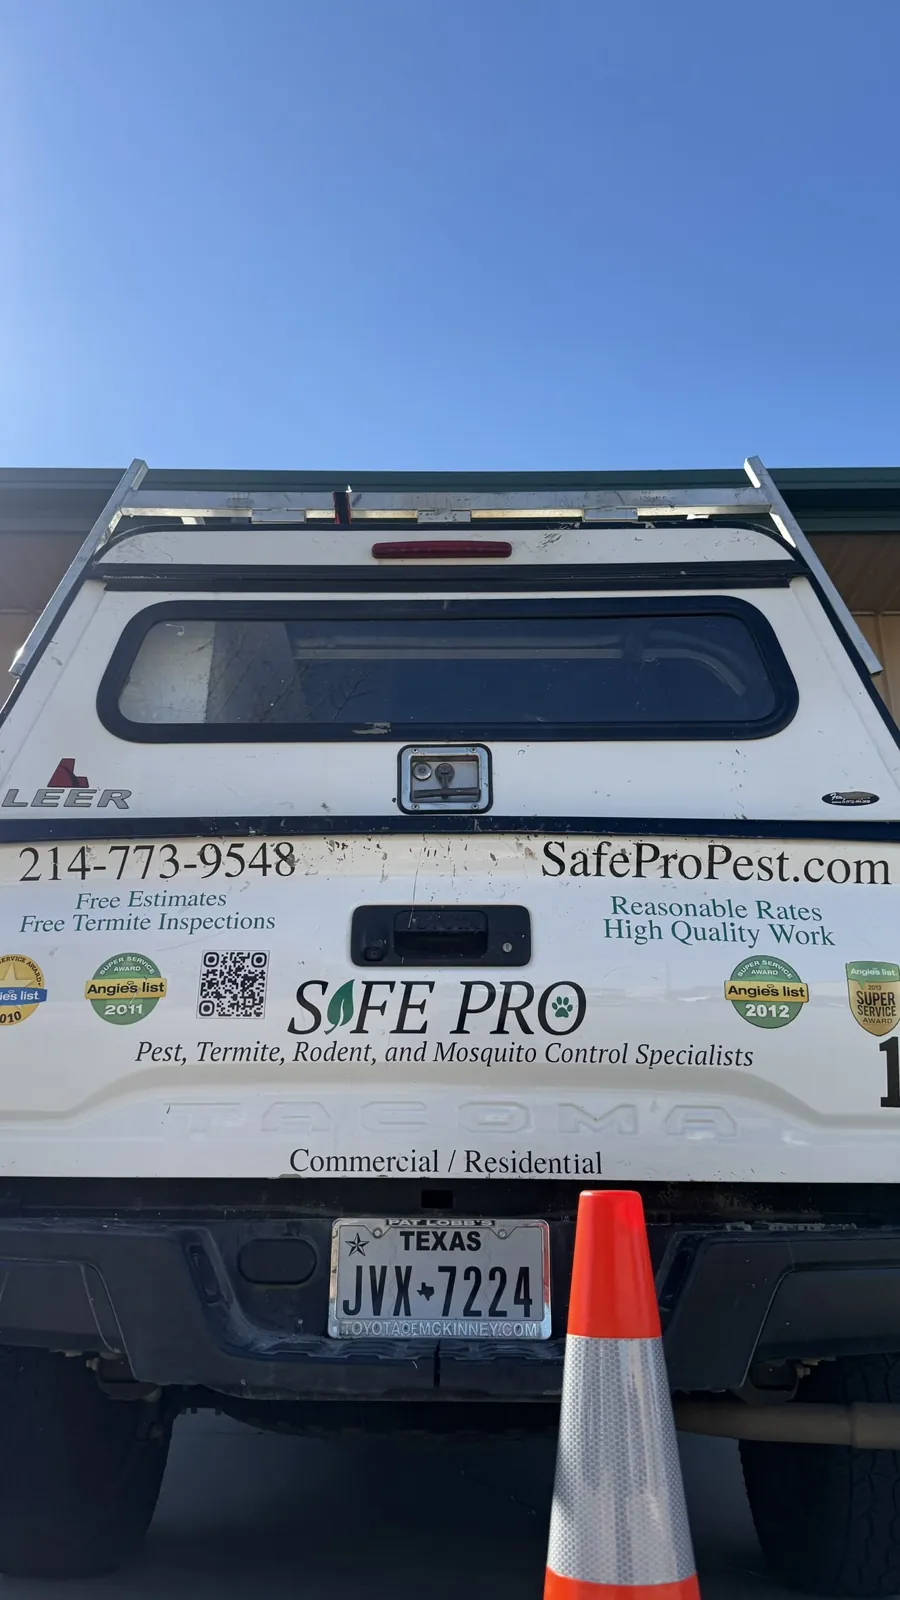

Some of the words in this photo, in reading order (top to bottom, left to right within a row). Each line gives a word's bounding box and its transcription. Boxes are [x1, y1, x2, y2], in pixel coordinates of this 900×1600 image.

[1, 788, 132, 810] LEER
[19, 841, 297, 882] 214-773-9548
[541, 840, 892, 885] SafeProPest.com
[75, 892, 121, 910] Free
[127, 890, 227, 908] Estimates
[610, 895, 748, 919] Reasonable
[755, 900, 823, 922] Rates
[19, 914, 65, 933] Free
[72, 913, 152, 932] Termite
[157, 911, 276, 935] Inspections
[603, 918, 663, 946] High
[671, 920, 760, 948] Quality
[767, 923, 836, 946] Work
[100, 957, 125, 976] SUPER
[126, 956, 156, 975] SERVICE
[737, 960, 760, 978] SUPER
[762, 960, 793, 979] SERVICE
[20, 990, 40, 1001] list
[142, 982, 165, 993] list
[783, 986, 805, 998] list
[449, 980, 587, 1036] PRO
[856, 990, 896, 1007] SUPER
[0, 1010, 22, 1024] 010
[104, 1004, 144, 1016] 2011
[745, 1003, 790, 1018] 2012
[857, 1004, 897, 1017] SERVICE
[134, 1041, 187, 1065] Pest,
[196, 1041, 286, 1065] Termite,
[292, 1041, 377, 1065] Rodent,
[384, 1041, 428, 1062] and
[433, 1041, 537, 1067] Mosquito
[545, 1042, 629, 1065] Control
[635, 1042, 754, 1069] Specialists
[289, 1149, 439, 1173] Commercial
[464, 1149, 603, 1175] Residential
[399, 1231, 482, 1252] TEXAS
[342, 1265, 412, 1317] JVX
[438, 1266, 533, 1318] 7224
